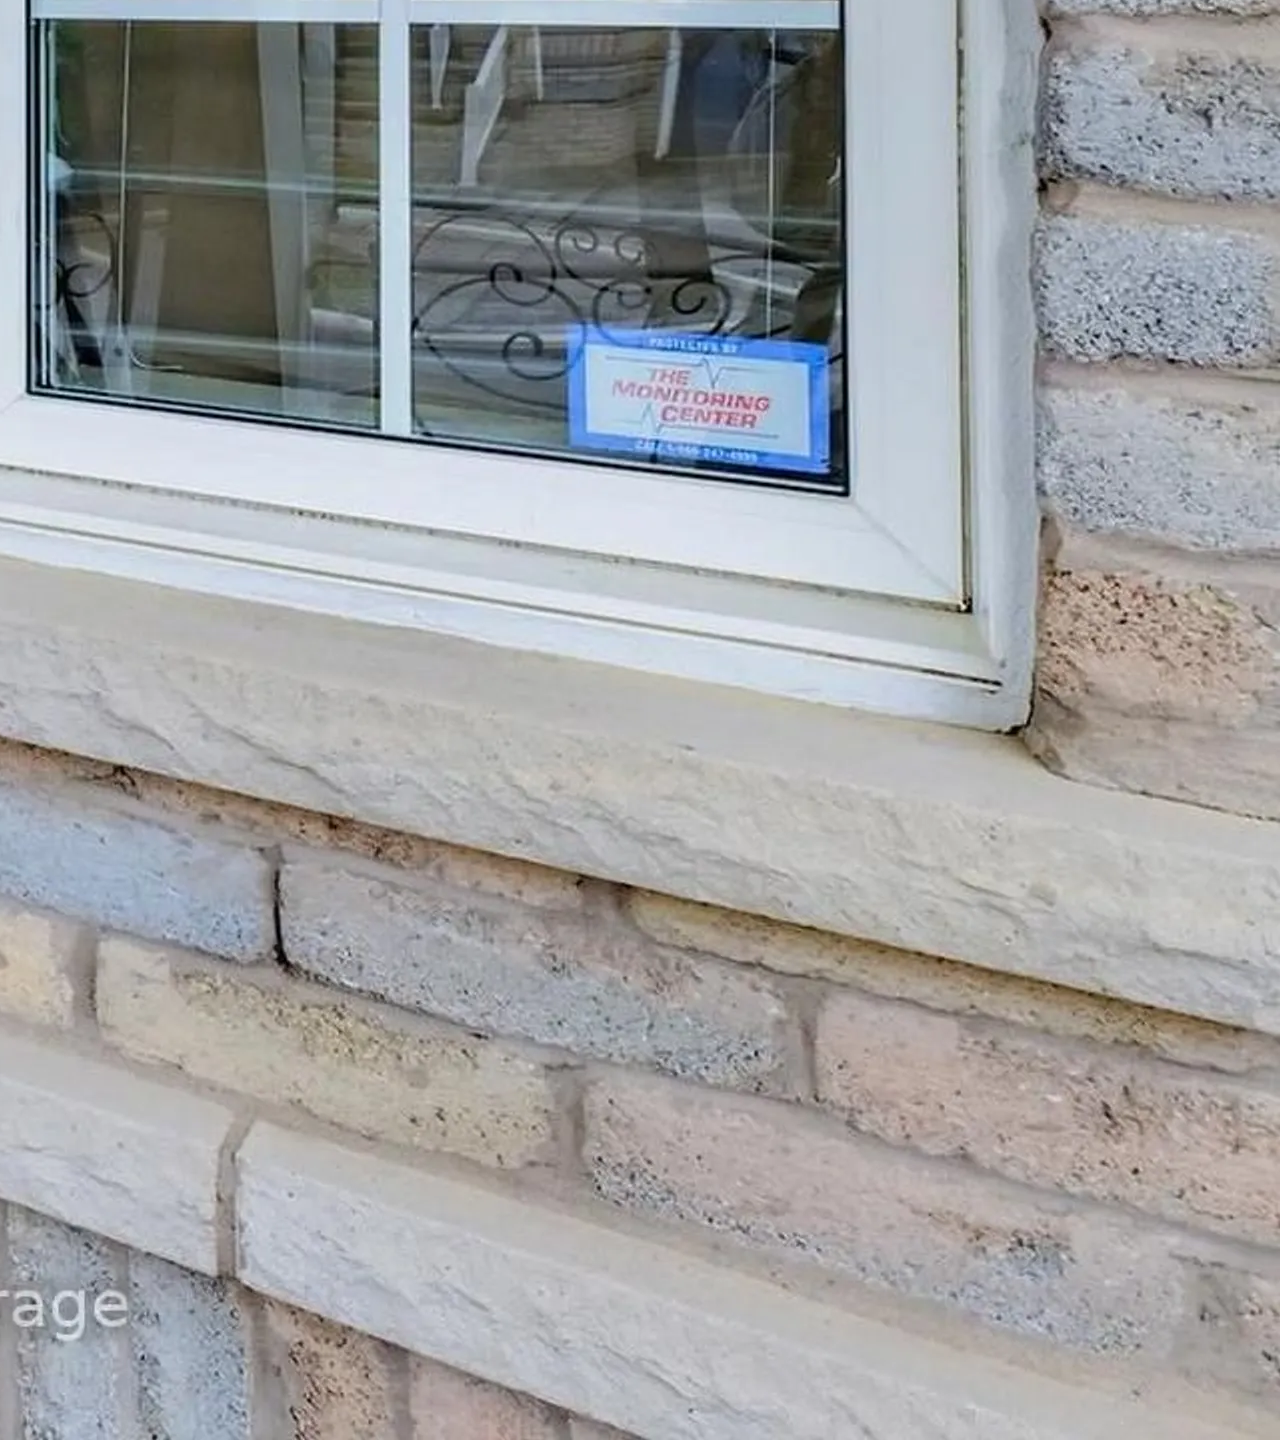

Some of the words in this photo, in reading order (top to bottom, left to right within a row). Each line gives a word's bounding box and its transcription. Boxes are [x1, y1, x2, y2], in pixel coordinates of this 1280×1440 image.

[649, 368, 691, 386] THE
[612, 380, 770, 412] MONITORING
[660, 405, 758, 429] CENTER
